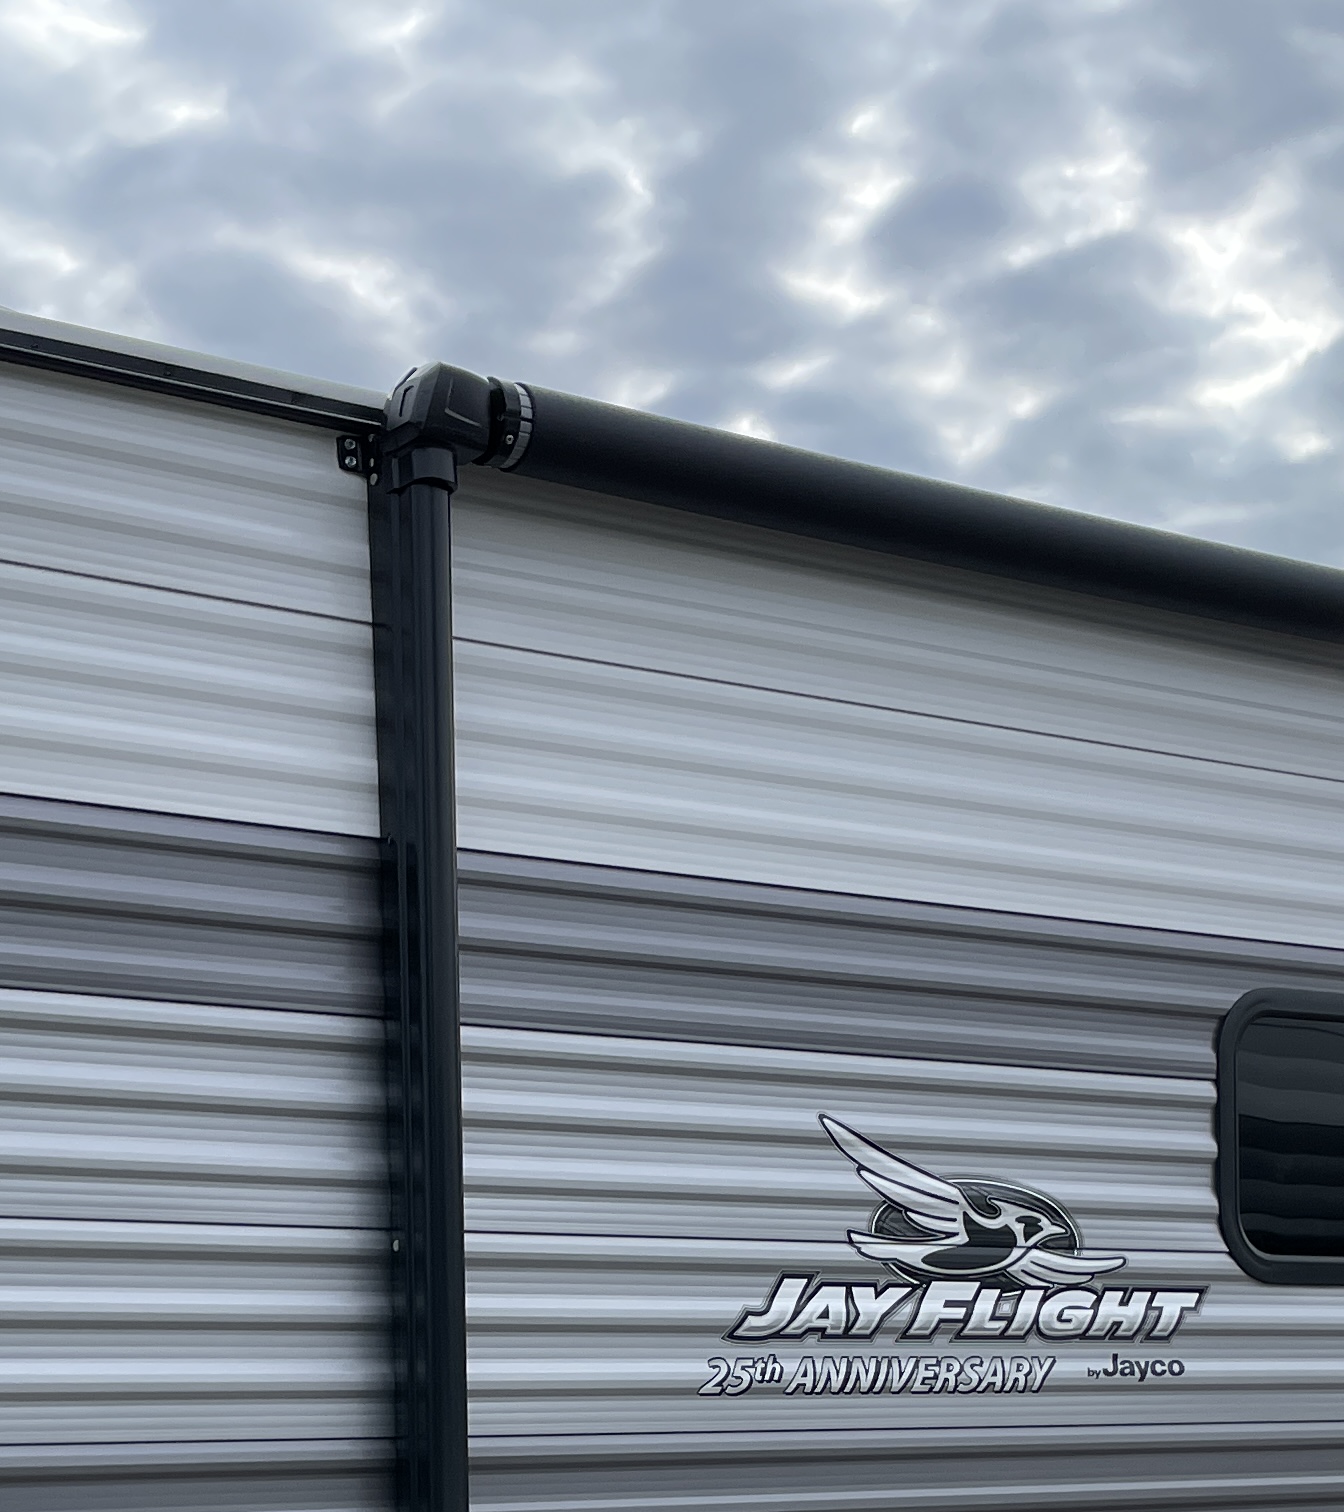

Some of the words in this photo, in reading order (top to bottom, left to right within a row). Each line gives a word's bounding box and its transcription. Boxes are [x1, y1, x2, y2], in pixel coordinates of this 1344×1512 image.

[722, 1271, 912, 1341] JAY
[897, 1281, 1210, 1342] FLIGHT
[697, 1354, 784, 1396] 25th
[784, 1355, 1058, 1396] ANNIVERSARY
[1087, 1366, 1102, 1381] by
[1102, 1353, 1186, 1382] Jayco
